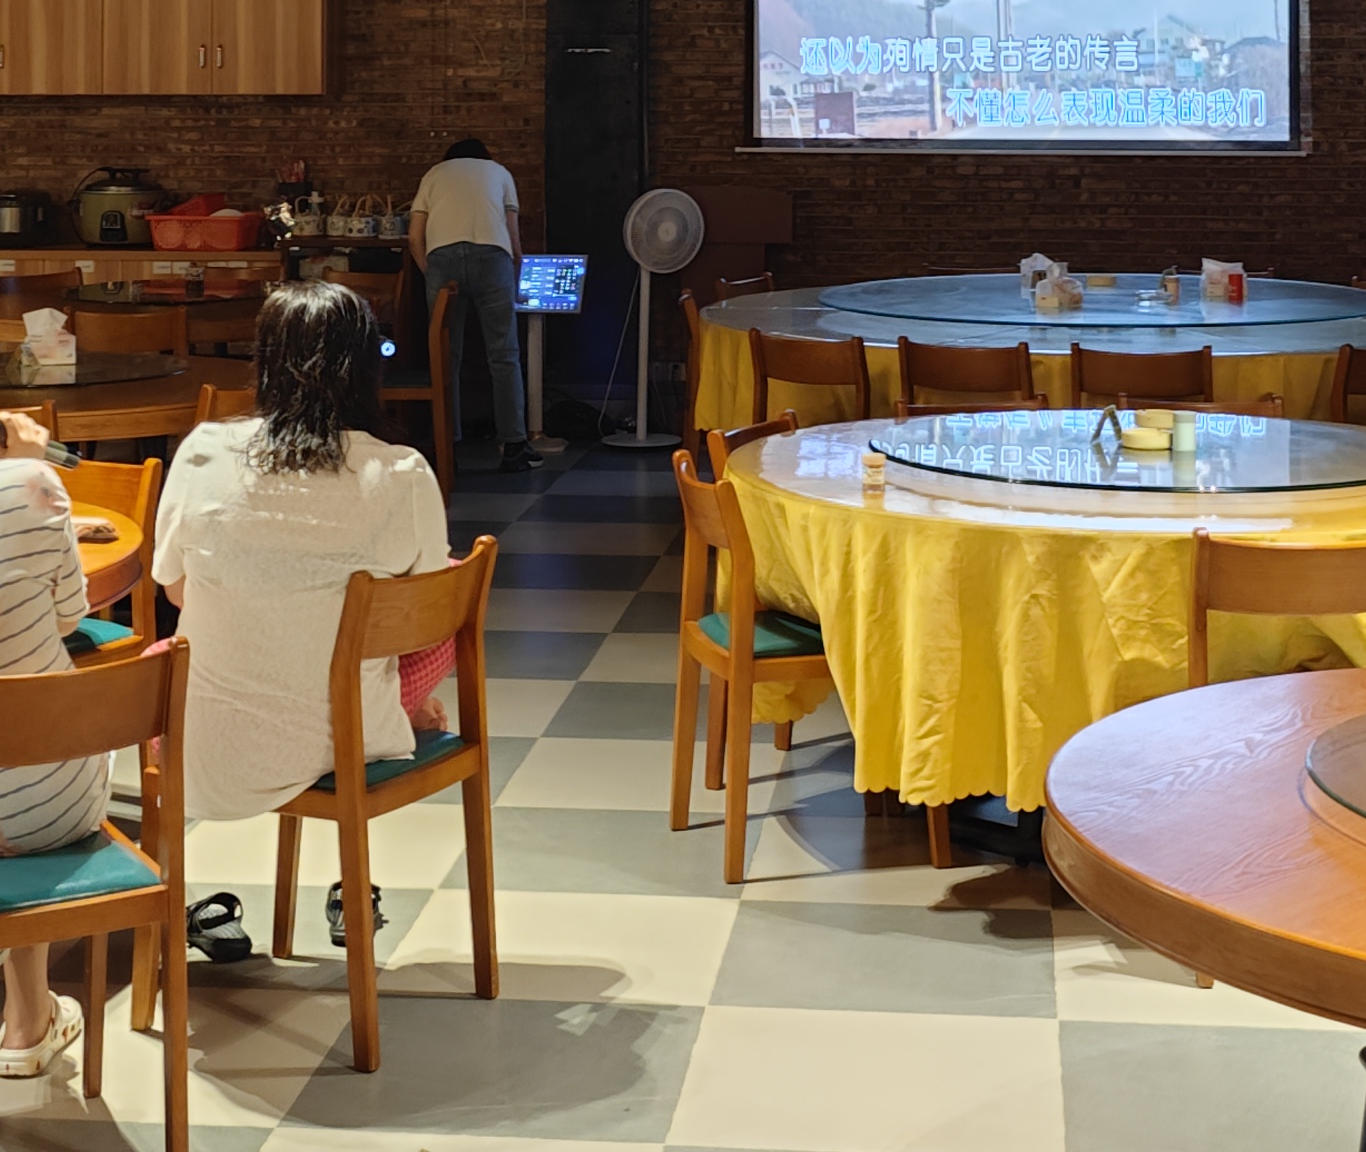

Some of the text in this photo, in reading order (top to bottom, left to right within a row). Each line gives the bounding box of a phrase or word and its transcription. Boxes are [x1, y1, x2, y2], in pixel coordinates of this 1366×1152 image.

[800, 35, 1139, 74] 还以为殉情只是古老的传言
[946, 88, 1267, 127] 不懂怎么表现温柔的我们
